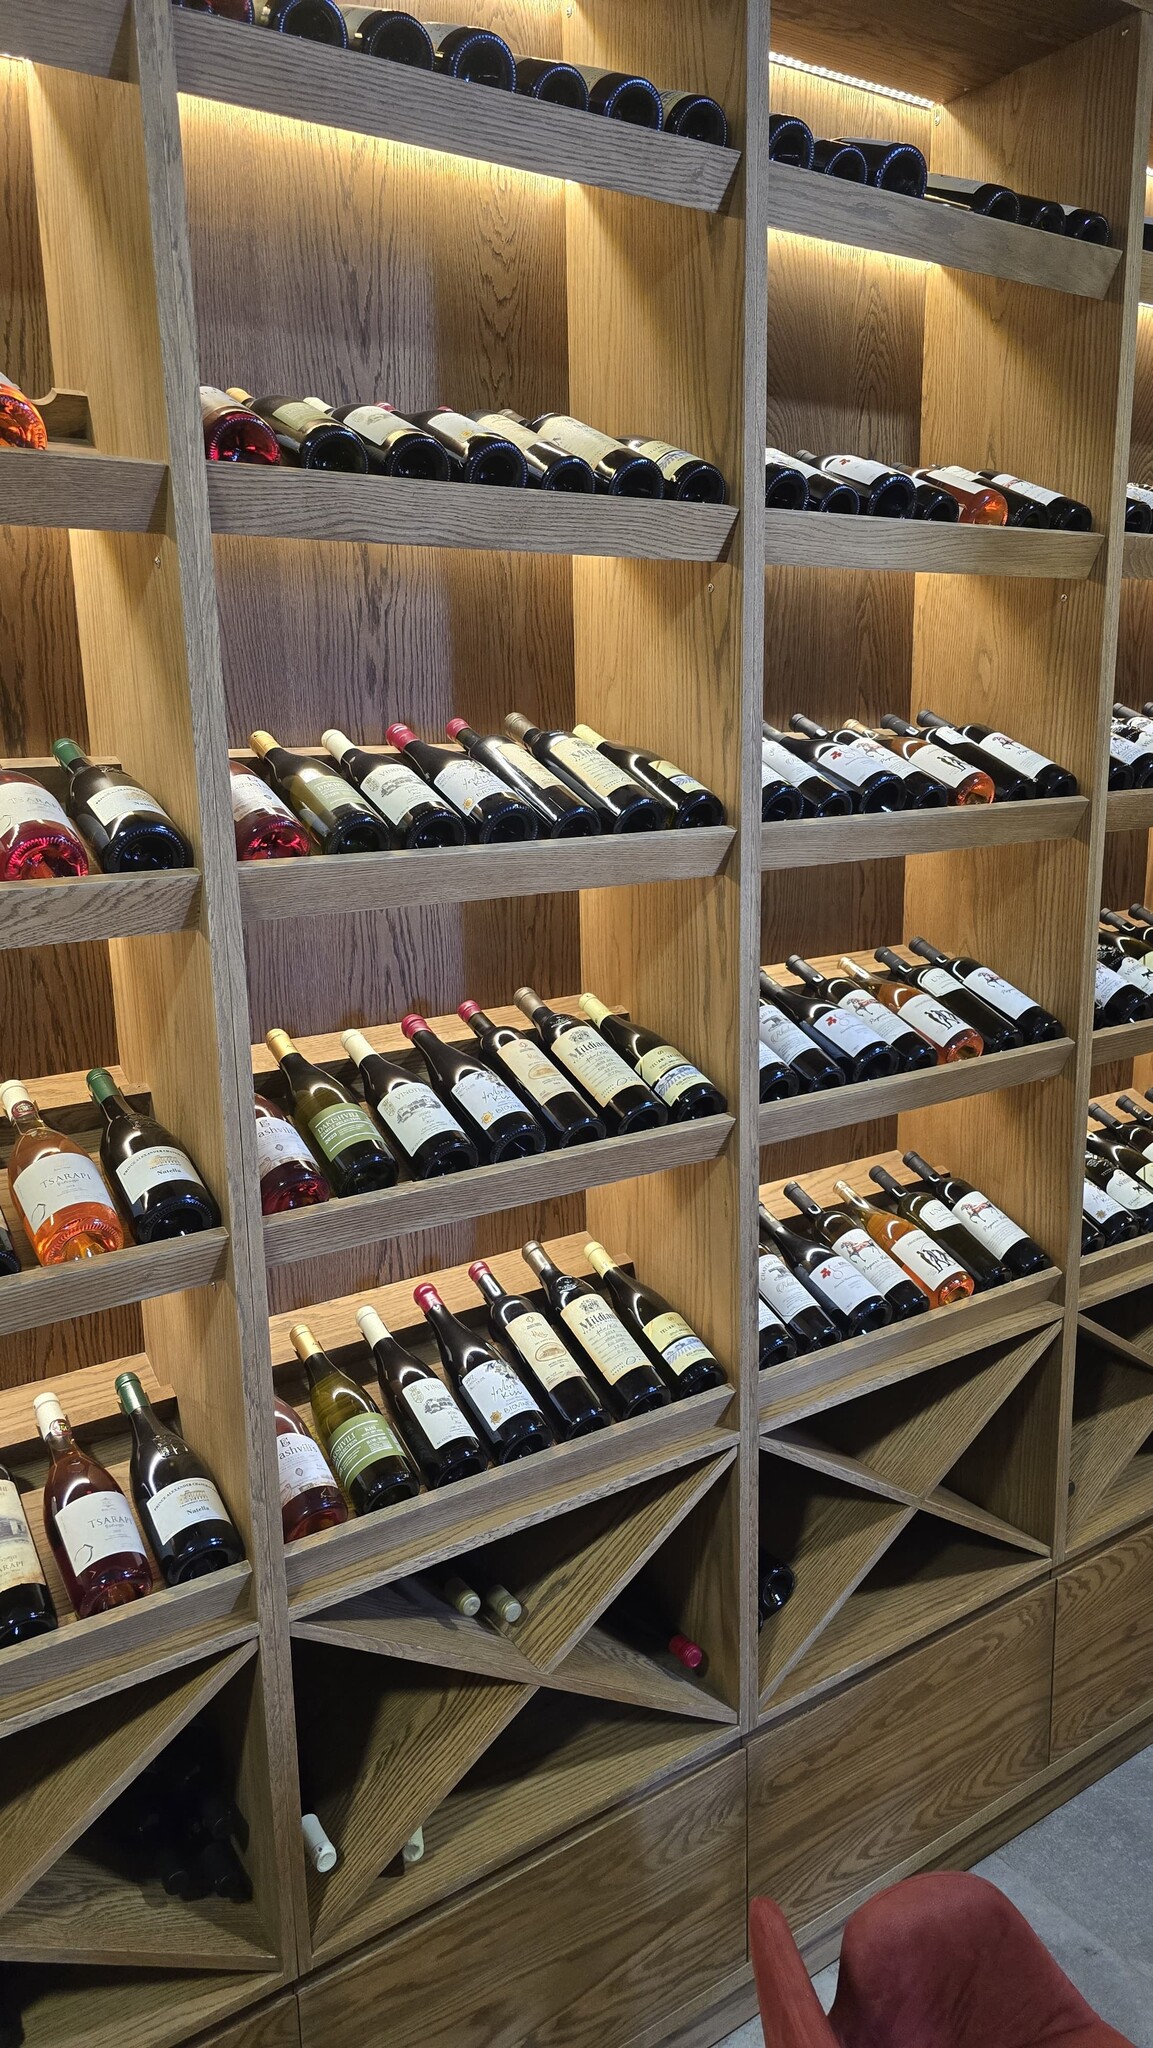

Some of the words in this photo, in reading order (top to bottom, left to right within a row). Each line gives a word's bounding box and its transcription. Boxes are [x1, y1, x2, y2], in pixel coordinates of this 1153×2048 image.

[40, 1172, 91, 1188] TSARAPI
[166, 1482, 192, 1497] ALEXANDER
[186, 1505, 210, 1516] Natella
[88, 1515, 133, 1529] TSARAPI
